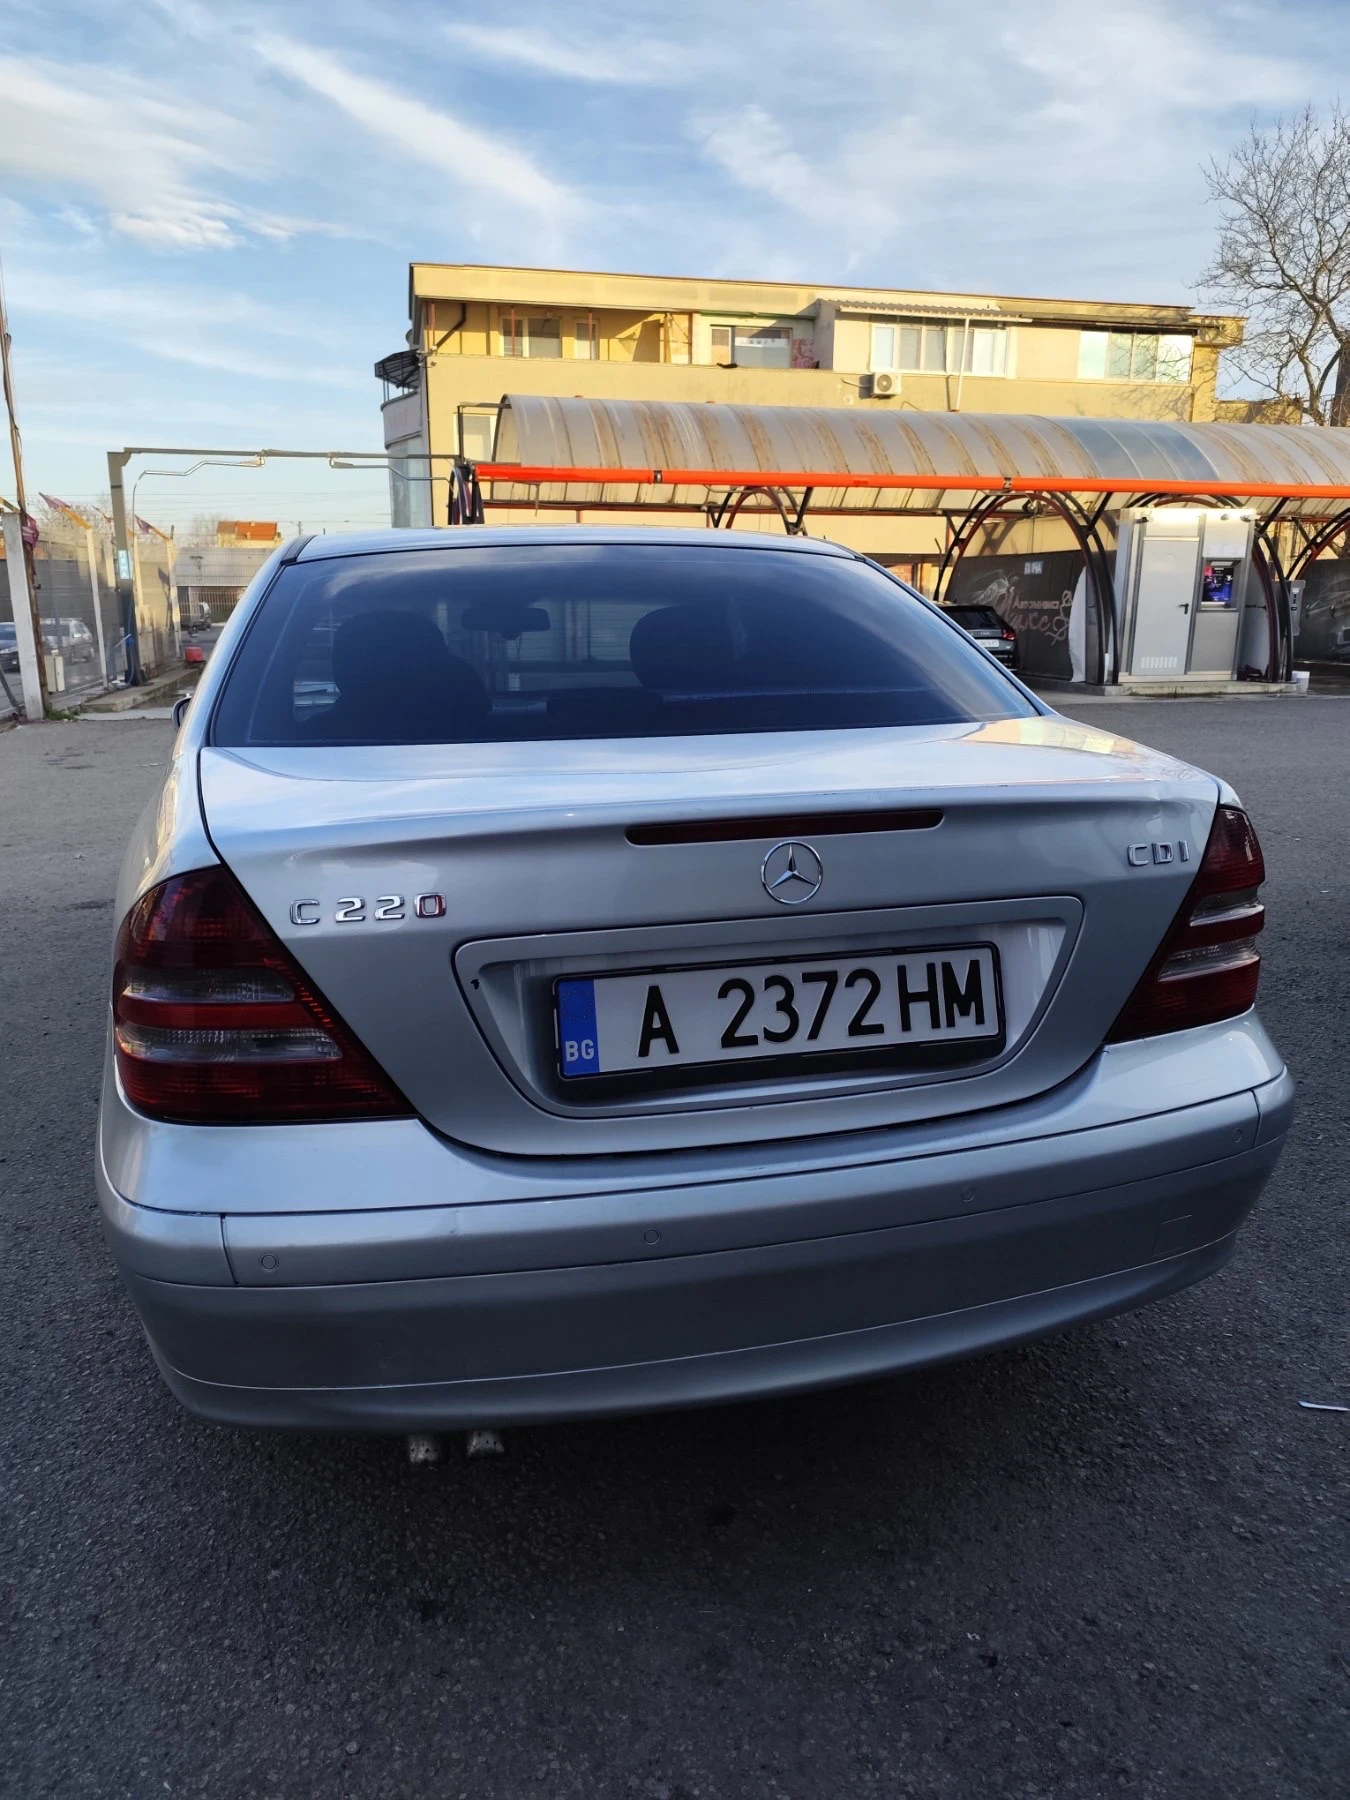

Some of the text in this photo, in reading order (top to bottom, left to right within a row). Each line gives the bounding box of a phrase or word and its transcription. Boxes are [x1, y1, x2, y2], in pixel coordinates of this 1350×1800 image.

[1127, 840, 1190, 867] CDI
[290, 893, 447, 925] C 220
[637, 959, 986, 1058] A 2372 HM
[565, 1039, 595, 1062] BG
